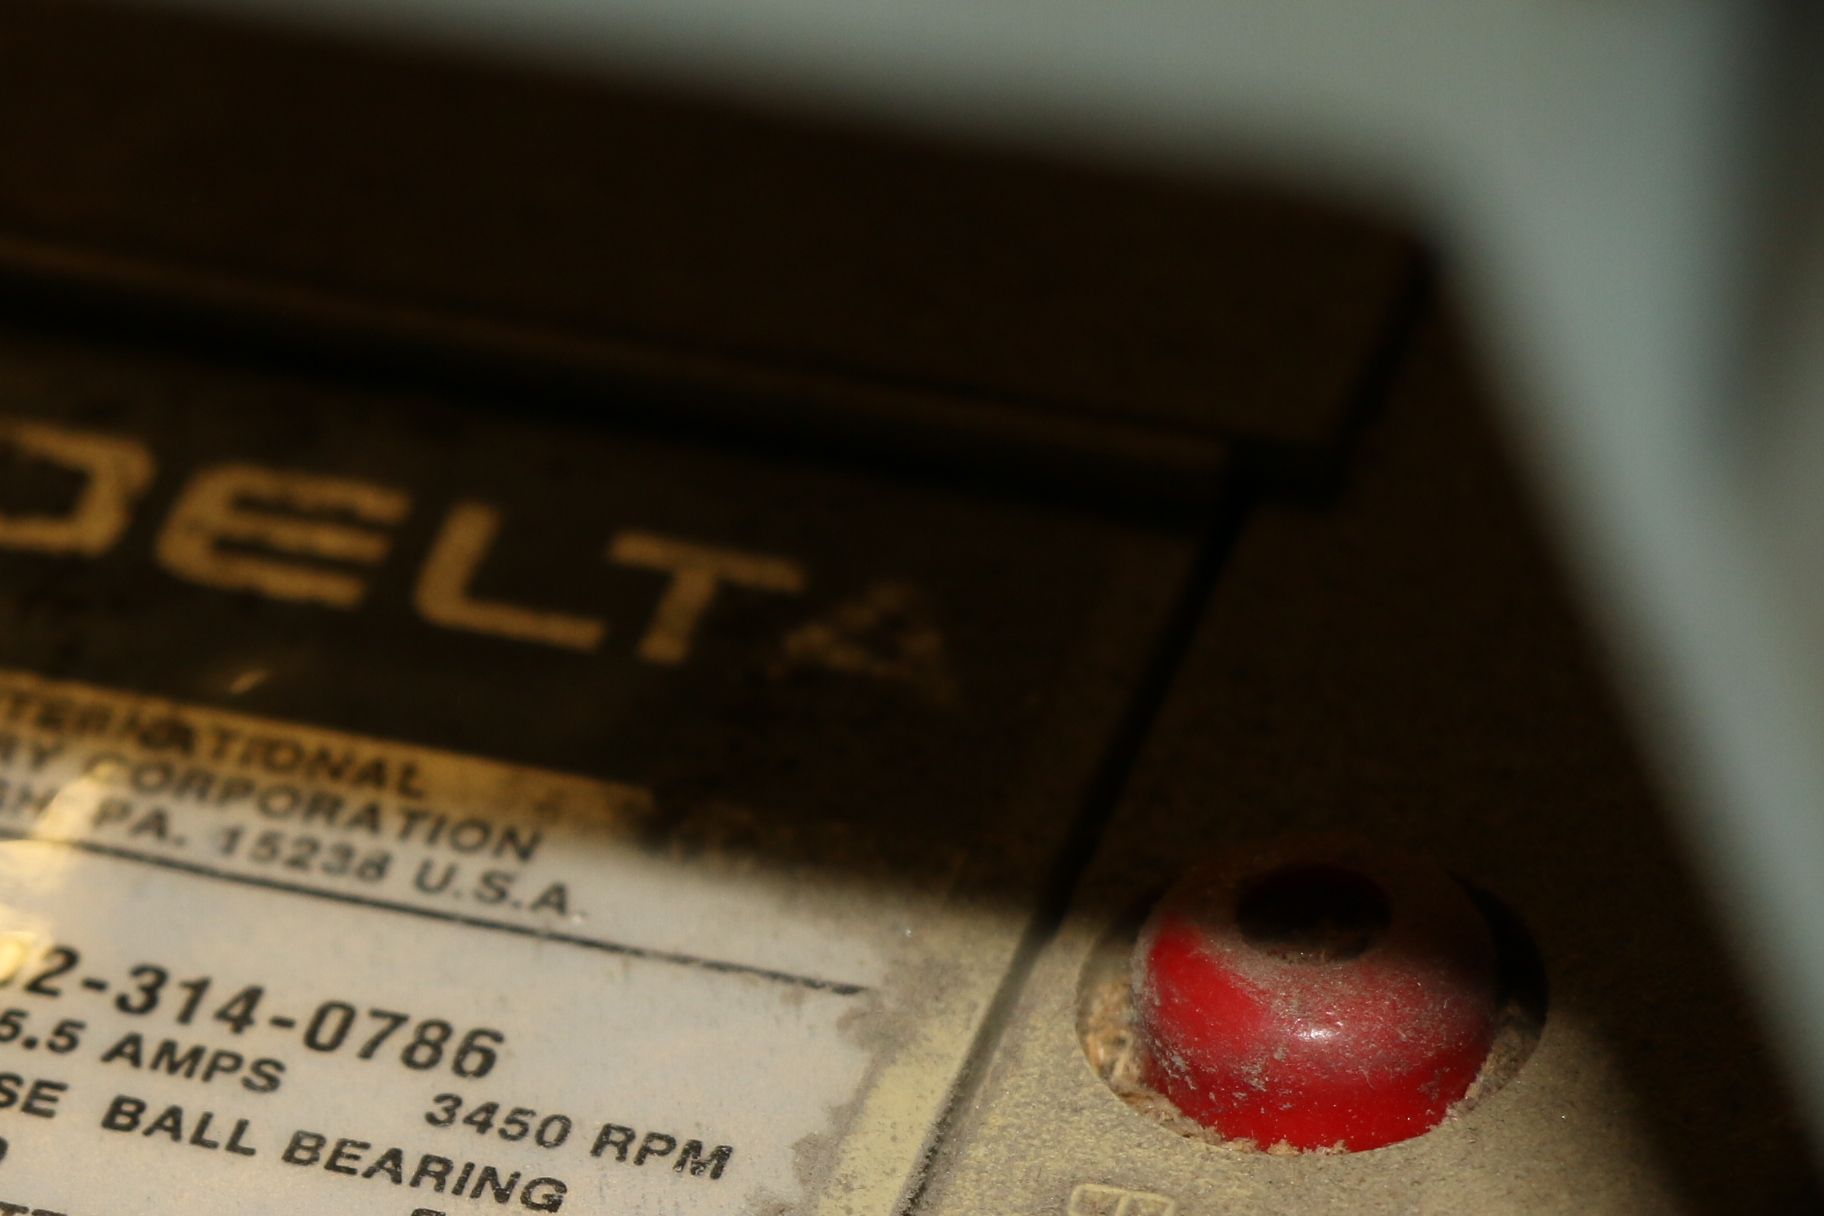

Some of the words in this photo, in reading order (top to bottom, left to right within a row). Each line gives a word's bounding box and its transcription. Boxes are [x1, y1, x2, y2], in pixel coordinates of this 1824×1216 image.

[84, 750, 542, 863] CORPORATION
[100, 1031, 287, 1094] AMPS
[423, 1092, 573, 1149] 3450
[590, 1122, 734, 1181] RPM
[100, 1094, 258, 1158] BALL
[280, 1129, 570, 1213] BEARING
